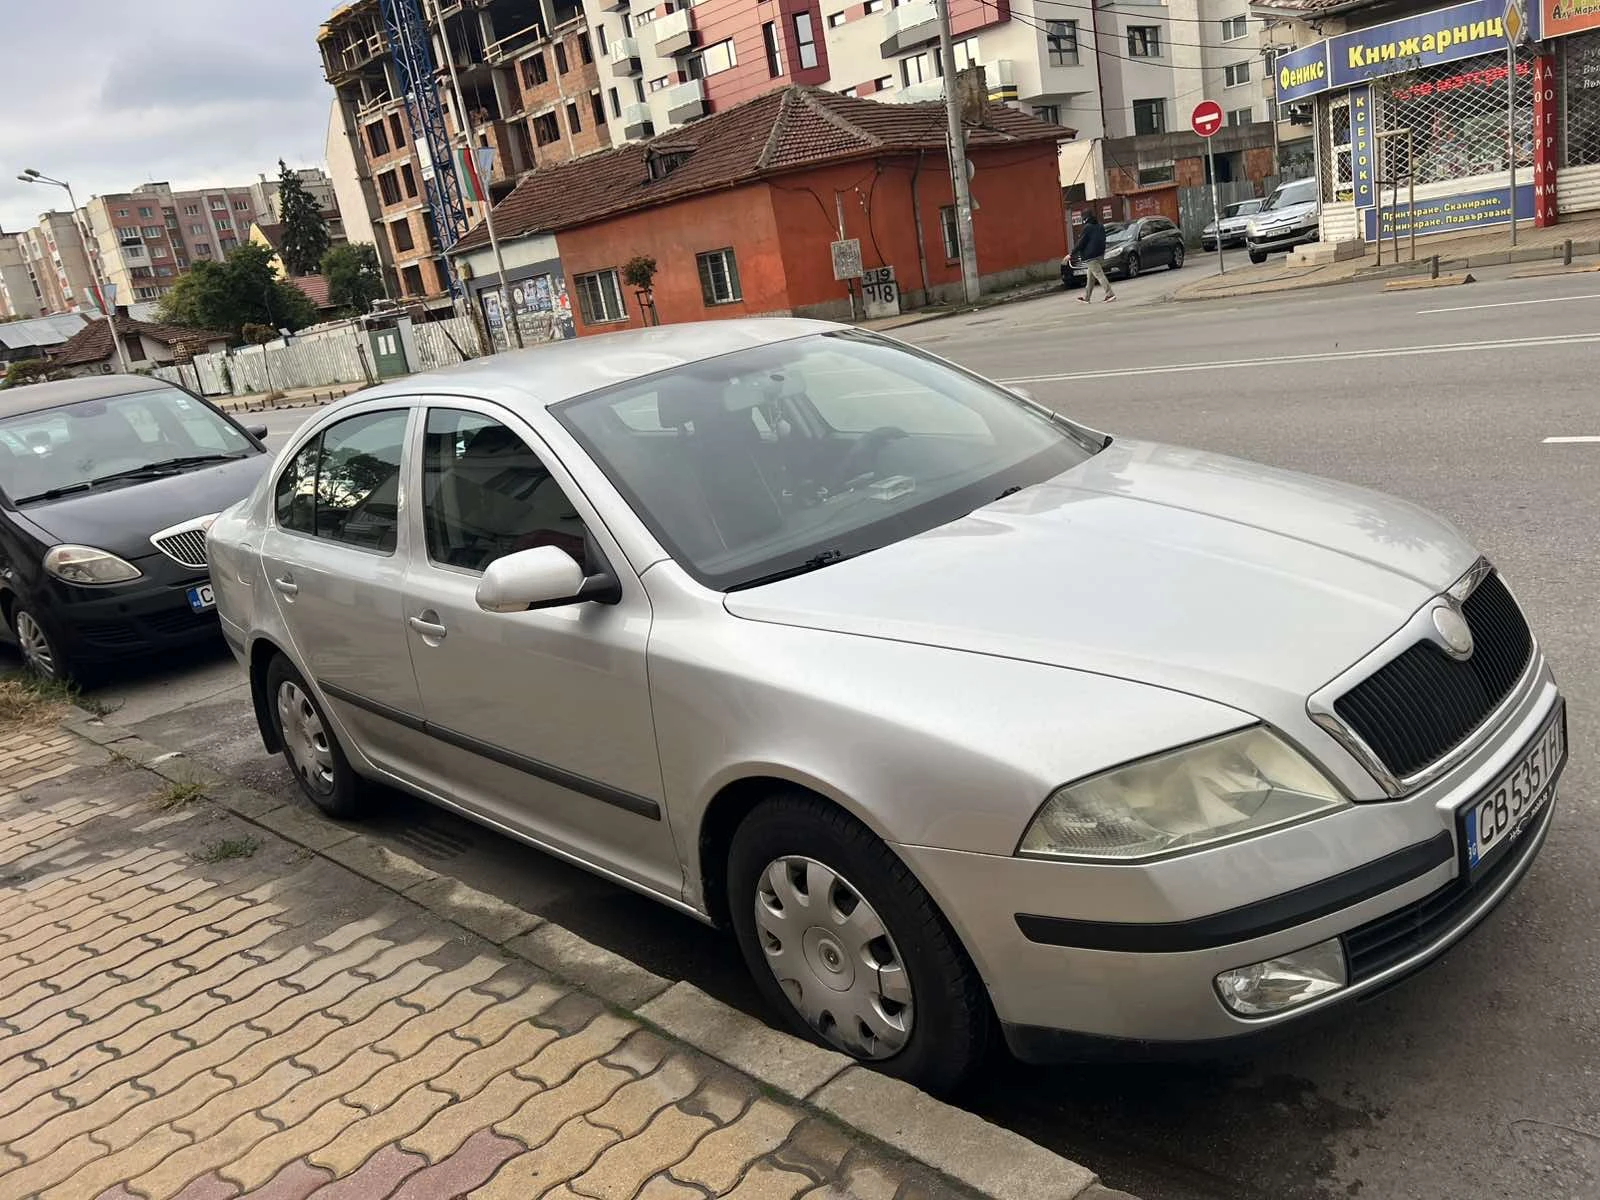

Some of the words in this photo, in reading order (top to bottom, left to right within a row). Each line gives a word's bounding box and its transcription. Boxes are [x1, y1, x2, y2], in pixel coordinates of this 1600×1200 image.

[1349, 16, 1504, 69] Книжарниц
[1280, 60, 1324, 91] Феникс
[1356, 97, 1368, 194] КСЕРОКС
[1511, 747, 1548, 817] 5351
